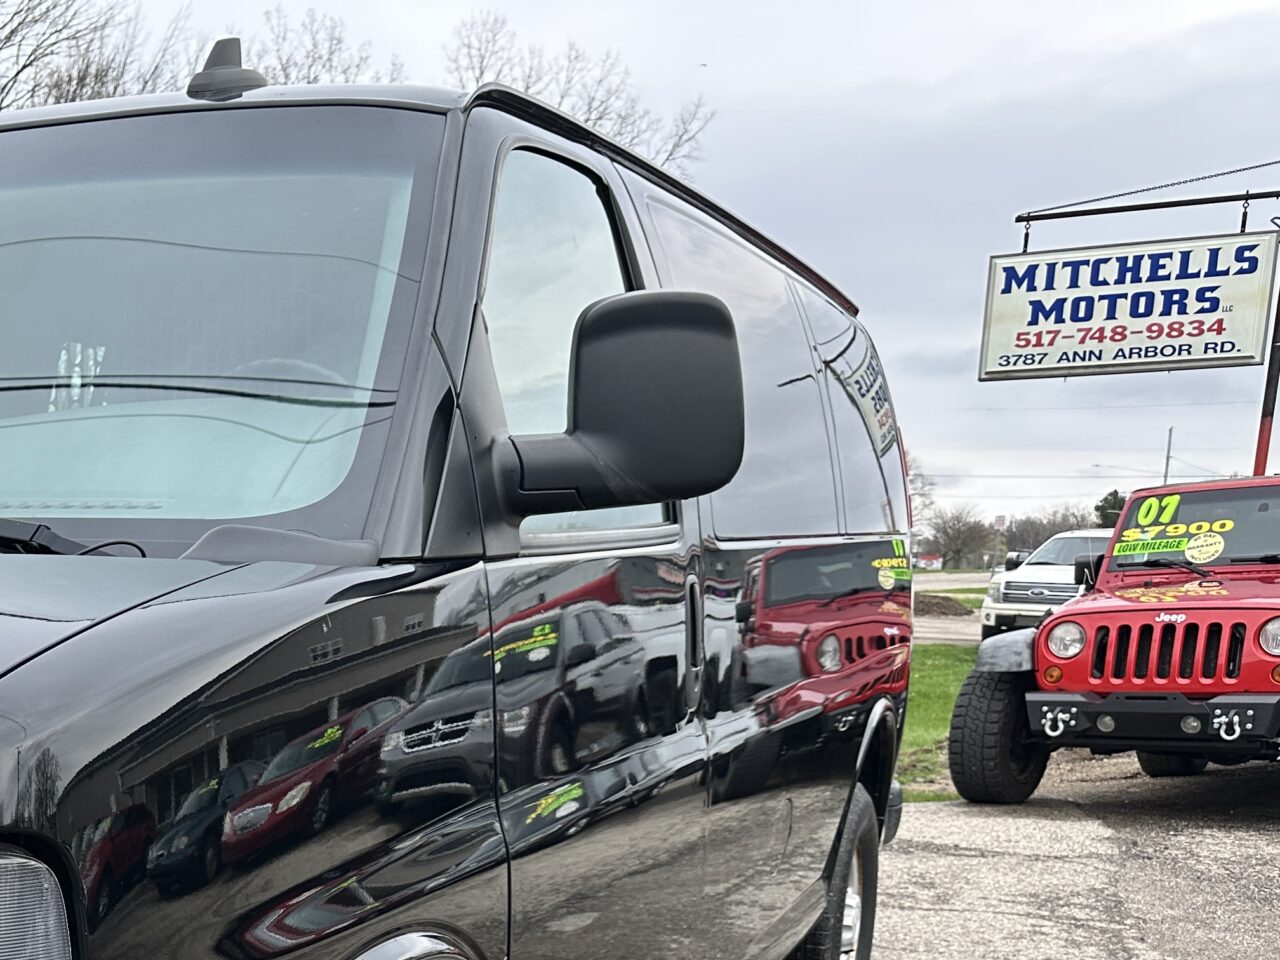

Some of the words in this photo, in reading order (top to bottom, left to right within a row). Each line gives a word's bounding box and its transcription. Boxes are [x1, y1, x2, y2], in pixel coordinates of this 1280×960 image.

[1000, 243, 1260, 295] MITCHELLS
[1026, 285, 1222, 326] MOTORS
[1222, 304, 1233, 313] LLC
[1014, 318, 1226, 349] 517-748-9834
[997, 352, 1048, 367] 3787
[1057, 349, 1103, 364] ANN
[1112, 343, 1192, 361] ARBOR
[1203, 341, 1241, 355] RD.
[1121, 519, 1235, 541] $7900
[1117, 541, 1140, 554] LOW
[1139, 539, 1184, 552] MILEAGE
[1187, 541, 1221, 550] WARRANTY
[1155, 612, 1186, 624] Jeep
